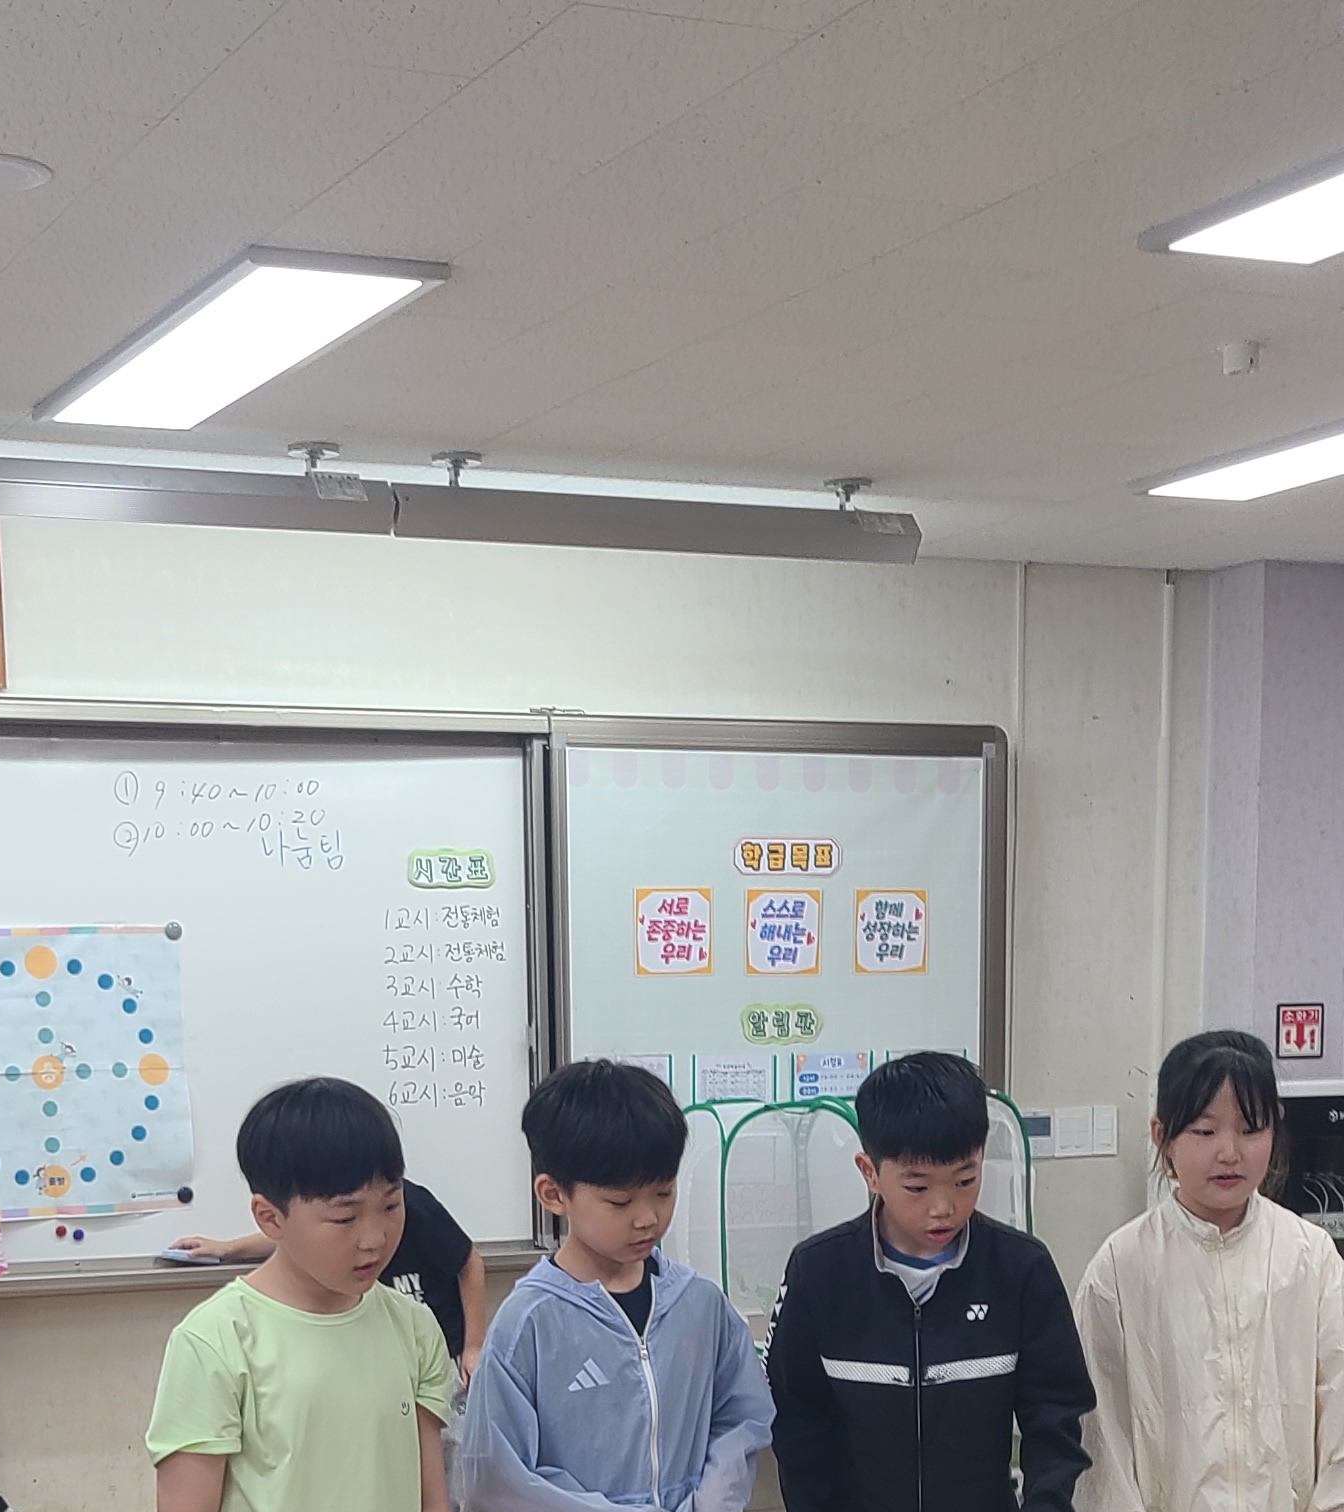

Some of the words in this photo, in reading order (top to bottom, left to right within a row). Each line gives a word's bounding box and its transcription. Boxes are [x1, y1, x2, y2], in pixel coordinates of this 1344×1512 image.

[262, 828, 344, 870] 나눔팀
[741, 841, 833, 871] 학급목표
[414, 856, 488, 883] 시간표
[658, 897, 692, 915] 서로
[761, 900, 806, 919] 스스로
[874, 899, 903, 919] 함께
[647, 919, 706, 941] 존중하는
[759, 922, 807, 943] 해내는
[861, 920, 919, 941] 성장하는
[660, 943, 692, 964] 우리
[767, 945, 799, 966] 우리
[875, 942, 904, 962] 우리
[747, 1010, 816, 1039] 알림판
[1284, 1011, 1318, 1022] 소화기
